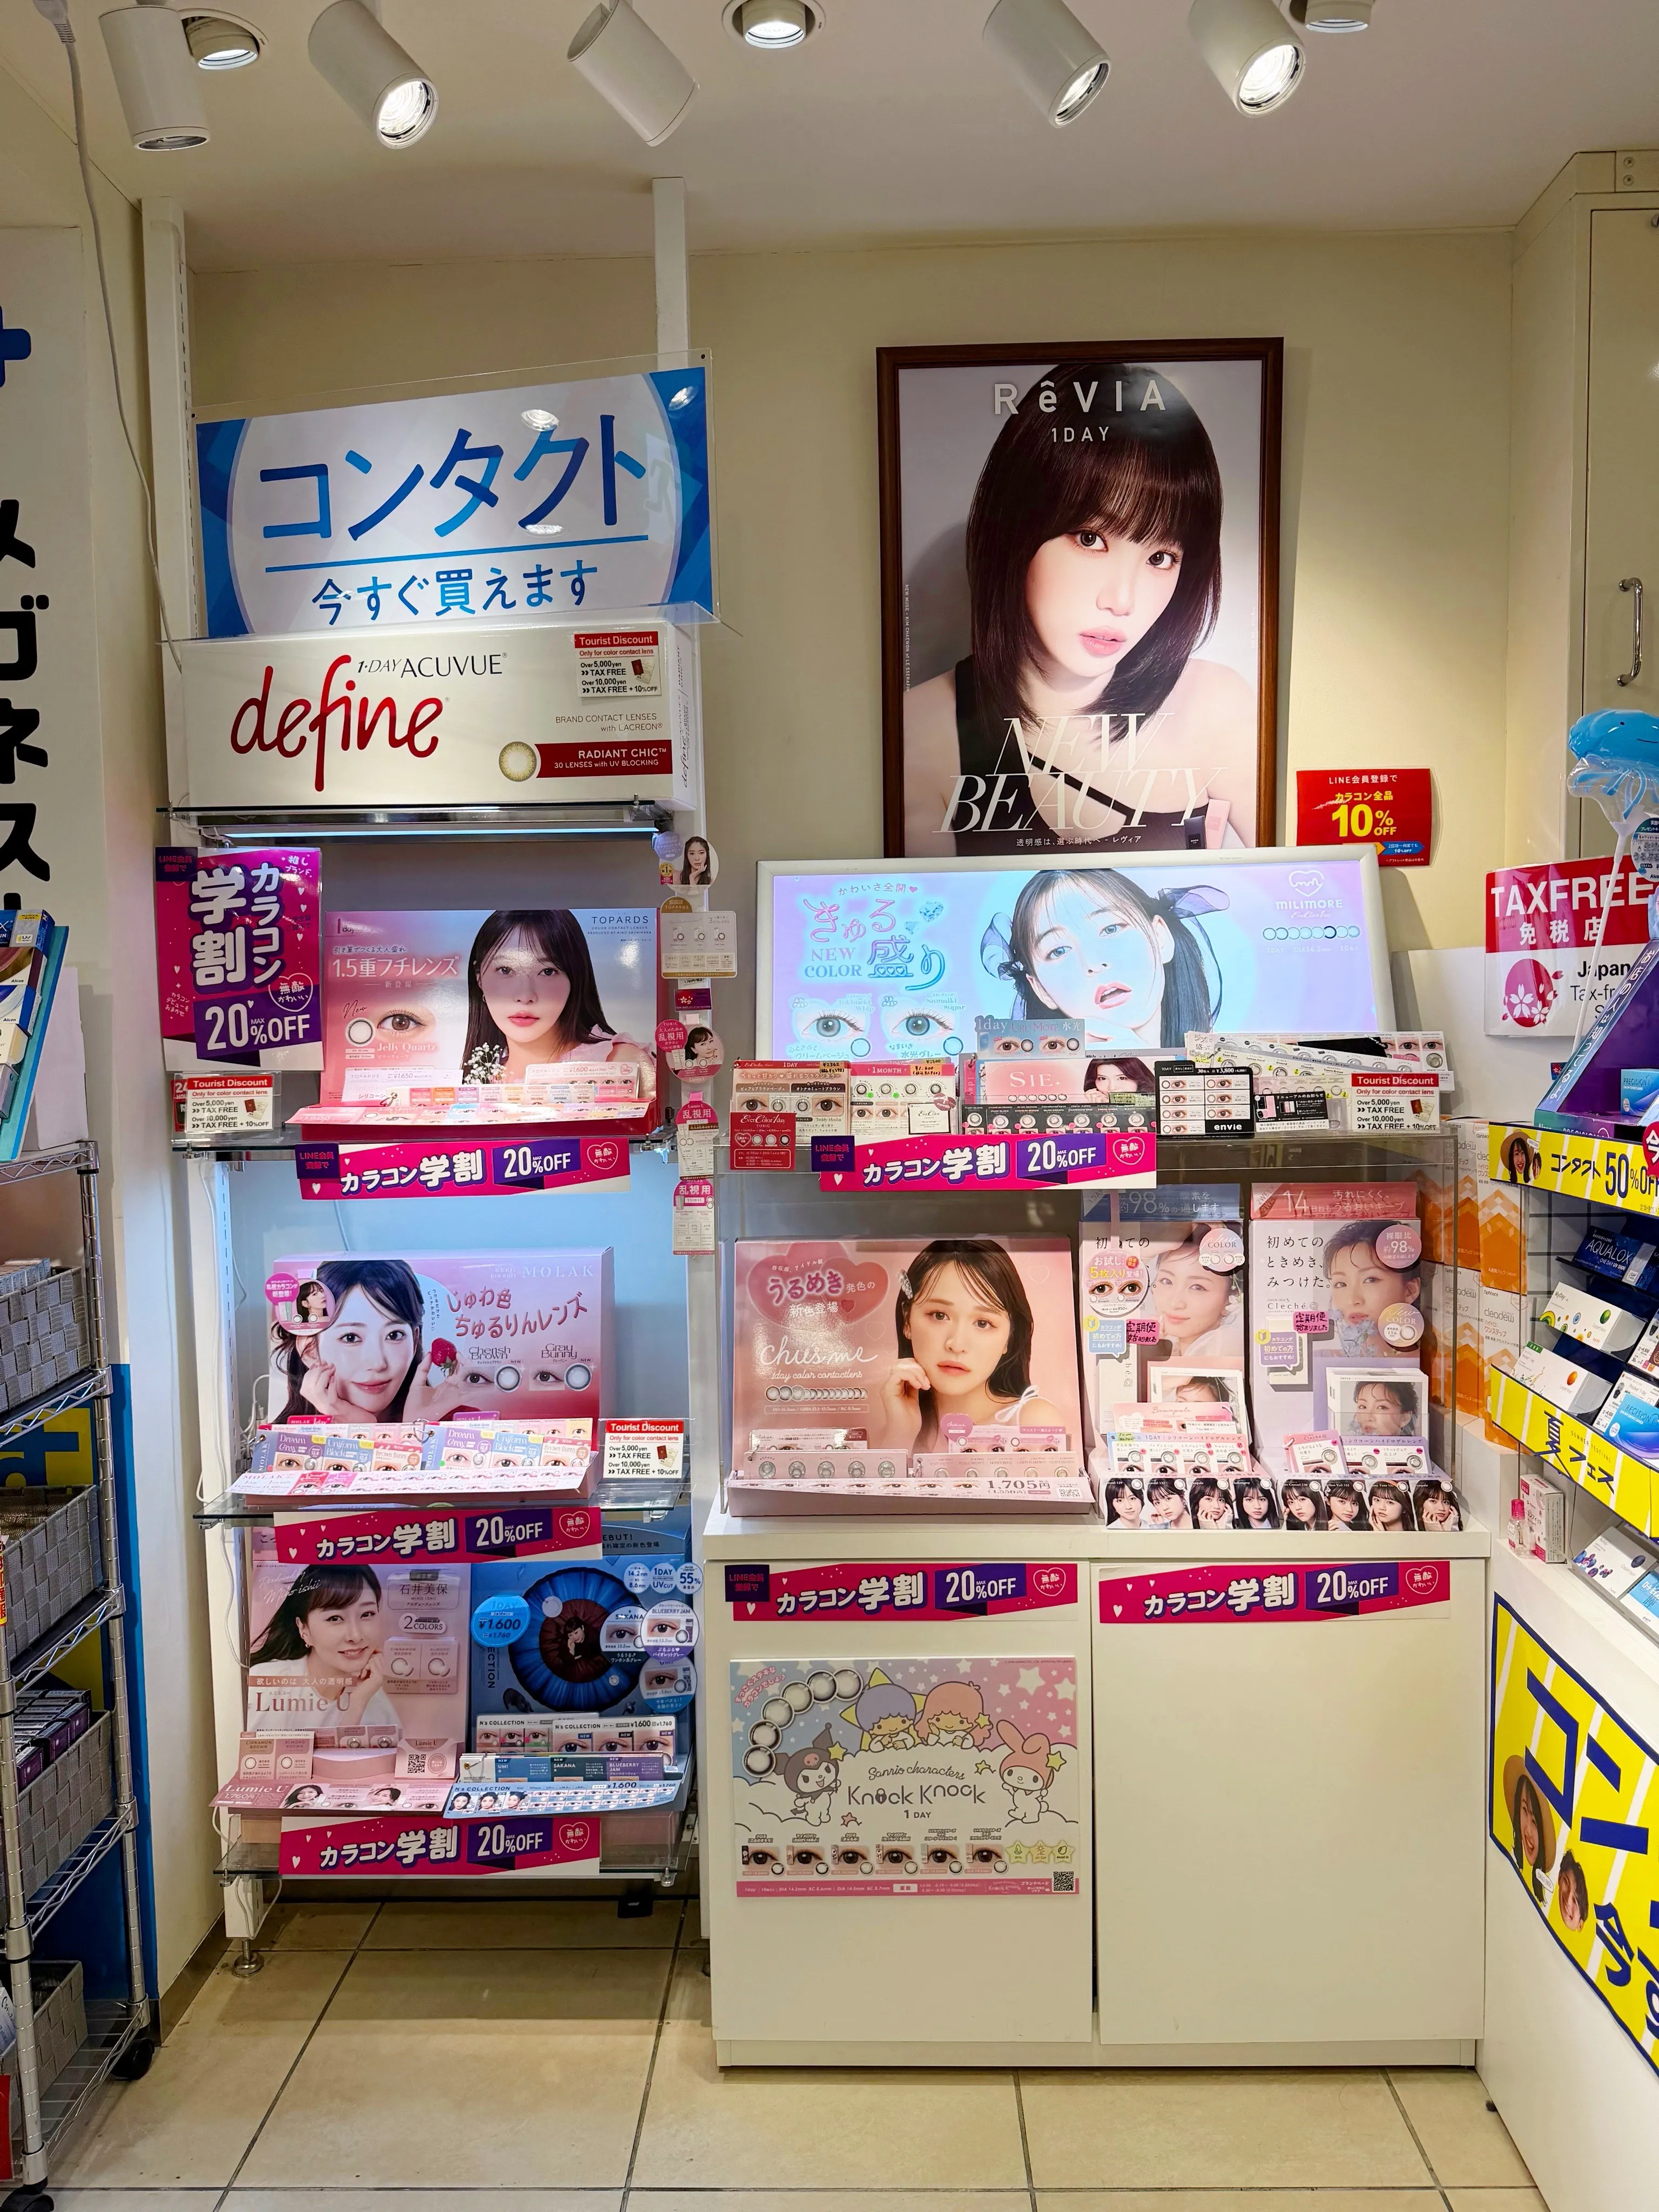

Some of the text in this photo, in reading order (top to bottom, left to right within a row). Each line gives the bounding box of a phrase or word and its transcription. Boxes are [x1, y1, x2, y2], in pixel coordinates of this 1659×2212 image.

[994, 379, 1166, 414] RêVIA
[1051, 427, 1110, 442] 1DAY
[260, 414, 646, 540] コンタクト
[312, 560, 597, 625] 今すぐ買えます
[579, 635, 652, 645] Tourist Discount
[987, 713, 1177, 776] NEW
[578, 749, 627, 759] RADIANT
[1329, 775, 1398, 784] LINE会員登録で
[933, 766, 1228, 833] BEAUTY
[1336, 791, 1393, 802] カラコン全品
[1374, 827, 1397, 836] OFF
[839, 882, 906, 896] かわいさ全開
[190, 867, 246, 986] 学割
[251, 862, 281, 983] カラコン
[1520, 916, 1602, 946] 免税店
[811, 947, 855, 961] NEW
[333, 956, 458, 977] 1.5重フチレンズ
[805, 965, 862, 978] COLOR
[279, 983, 304, 994] 無敵
[1062, 1022, 1081, 1031] 水光
[658, 1032, 684, 1041] 乱視用
[377, 1042, 436, 1052] Jelly Quartz
[227, 1078, 268, 1087] Discount
[1358, 1076, 1433, 1084] Tourist Discount
[683, 1109, 711, 1118] 乱視用
[503, 1147, 571, 1178] 20%OFF
[864, 1143, 1006, 1184] カラコン学割
[1028, 1141, 1095, 1172] 20%OFF
[341, 1150, 483, 1193] カラコン学割
[1551, 1154, 1601, 1179] コンタクト
[679, 1185, 710, 1195] 乱視用
[1267, 1236, 1323, 1249] 初めての
[1586, 1239, 1633, 1264] AQUALOX
[522, 1265, 594, 1278] MOLAK
[768, 1270, 842, 1304] うるめき
[446, 1286, 511, 1313] じゅわ色
[790, 1301, 839, 1317] 新色登場
[1296, 1312, 1327, 1323] 定期便
[546, 1343, 573, 1352] Gray
[471, 1352, 508, 1360] Brown
[542, 1351, 577, 1360] Bunny
[771, 1370, 791, 1379] 1day
[793, 1370, 815, 1379] color
[611, 1422, 679, 1432] Tourist Discount
[280, 1434, 306, 1444] Dream
[1572, 1431, 1611, 1463] SUMMER FESTIVAL
[317, 1519, 455, 1557] カラコン学割
[476, 1516, 542, 1547] 20%OFF
[400, 1584, 448, 1596] 石井美保
[777, 1572, 923, 1614] カラコン学割
[946, 1570, 1016, 1603] 20%OFF
[1317, 1570, 1388, 1603] 20%OFF
[1144, 1574, 1293, 1616] カラコン学割
[404, 1616, 413, 1629] 2
[256, 1692, 351, 1711] Lumie U
[868, 1762, 966, 1781] Sanrio characters
[226, 1784, 272, 1792] Lumie
[920, 1784, 986, 1805] Knock
[904, 1810, 909, 1819] 1
[320, 1827, 457, 1867] カラコン学割
[478, 1824, 543, 1857] 20%OFF
